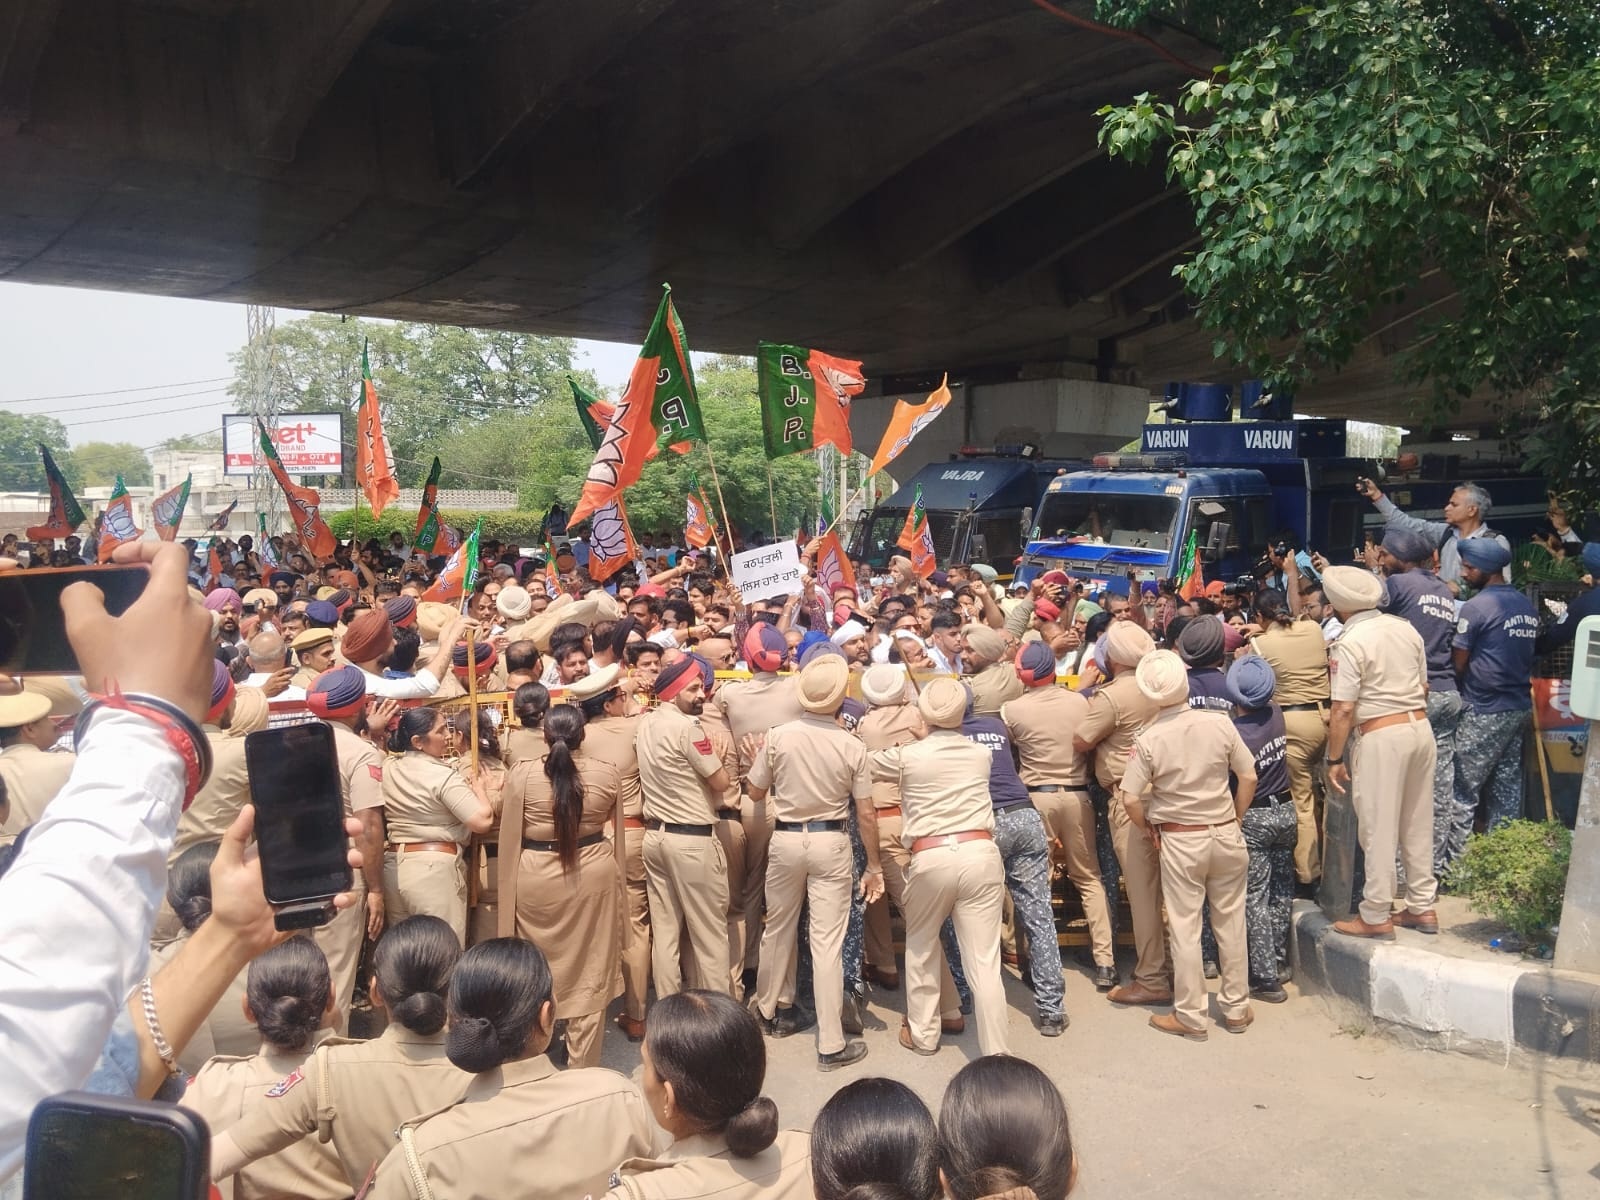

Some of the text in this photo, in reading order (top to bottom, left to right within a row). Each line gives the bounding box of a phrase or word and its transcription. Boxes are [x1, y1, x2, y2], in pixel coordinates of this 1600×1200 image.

[1146, 430, 1189, 448] VARUN
[1244, 430, 1293, 449] VARUN
[940, 470, 985, 481] VAJRA
[742, 549, 783, 569] ਕਠਪੁਤਲੀ
[1417, 594, 1441, 605] ANTI
[1503, 614, 1538, 630] ANTI RIO
[1188, 696, 1206, 706] NTI
[977, 732, 1006, 744] RIOT
